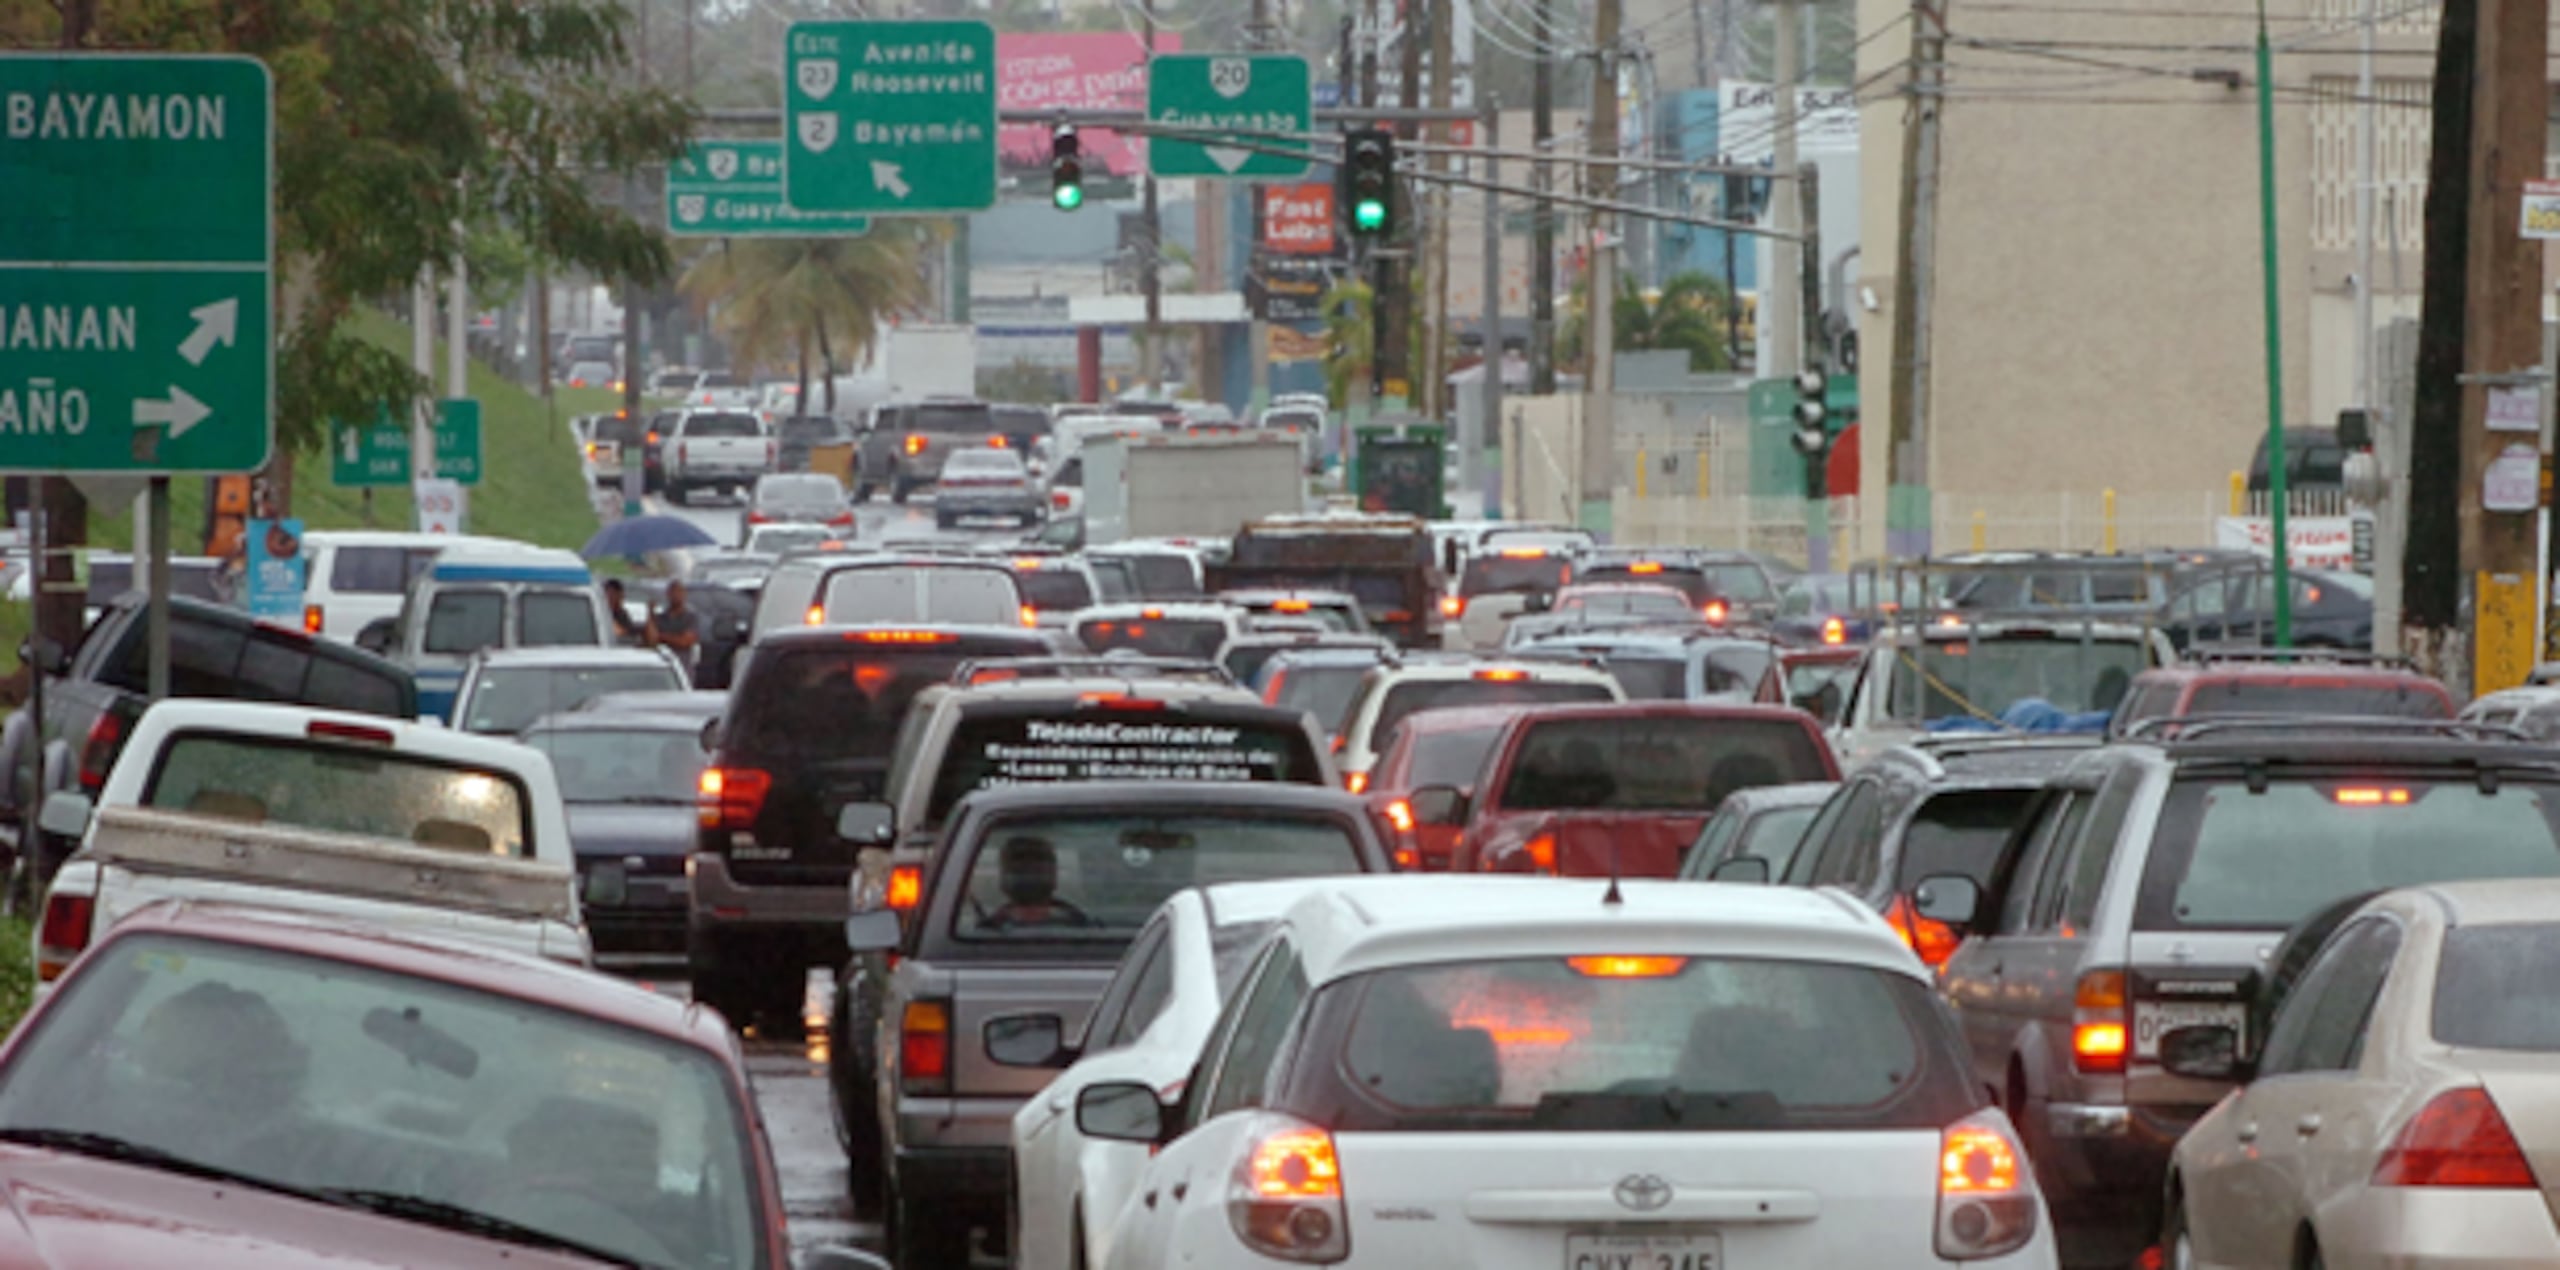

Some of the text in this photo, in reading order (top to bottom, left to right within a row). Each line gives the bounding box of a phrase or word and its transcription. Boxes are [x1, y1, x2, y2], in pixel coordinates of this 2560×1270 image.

[863, 41, 975, 64] Avenida
[803, 66, 831, 87] 23
[852, 71, 985, 93] Roosevelt
[1214, 62, 1246, 87] 20
[7, 94, 226, 140] BAYAMON
[810, 120, 827, 143] 2
[1267, 197, 1327, 219] Fast
